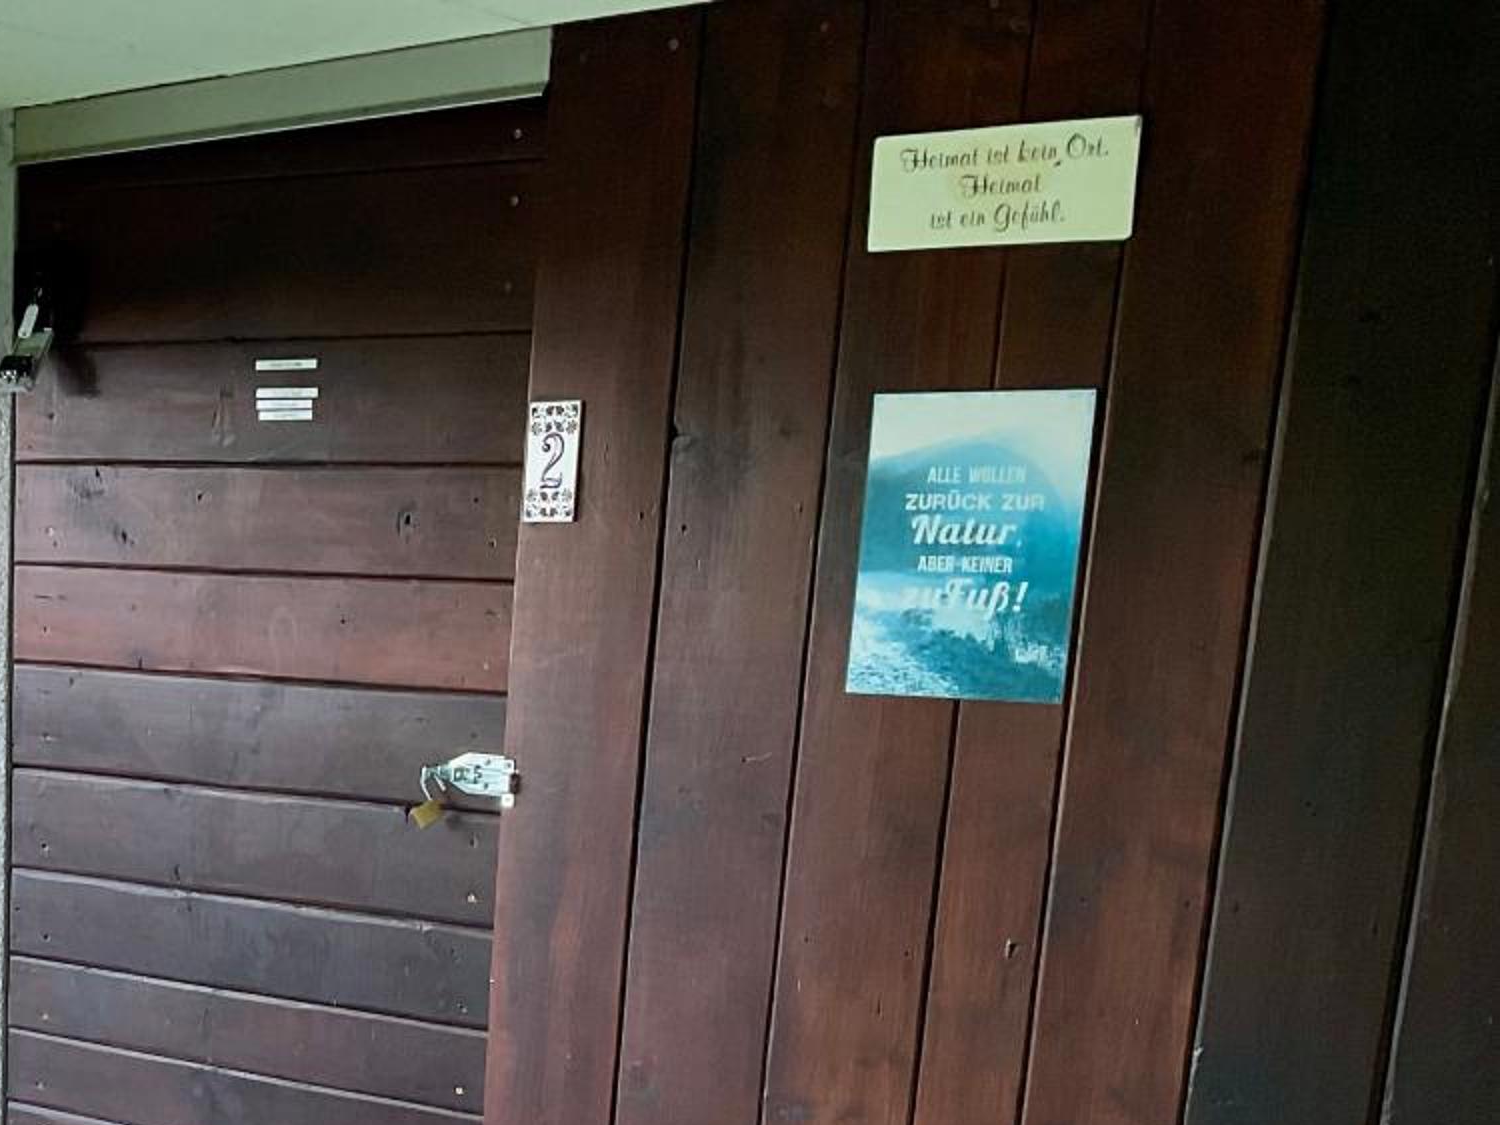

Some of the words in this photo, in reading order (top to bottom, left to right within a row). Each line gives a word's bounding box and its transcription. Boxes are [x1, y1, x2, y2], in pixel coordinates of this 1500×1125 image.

[900, 147, 978, 173] Heimat
[987, 144, 1009, 164] ist
[958, 172, 1040, 198] Heimat
[931, 210, 951, 229] ist
[960, 209, 985, 227] ein
[539, 431, 565, 489] 2
[926, 466, 963, 484] ALLE
[968, 464, 1027, 484] WOLLEN
[905, 489, 990, 511] ZURÜCK
[1001, 493, 1045, 512] ZUR
[917, 555, 954, 573] ABER
[961, 555, 1013, 574] KEINER
[945, 577, 1029, 621] Fuß!
